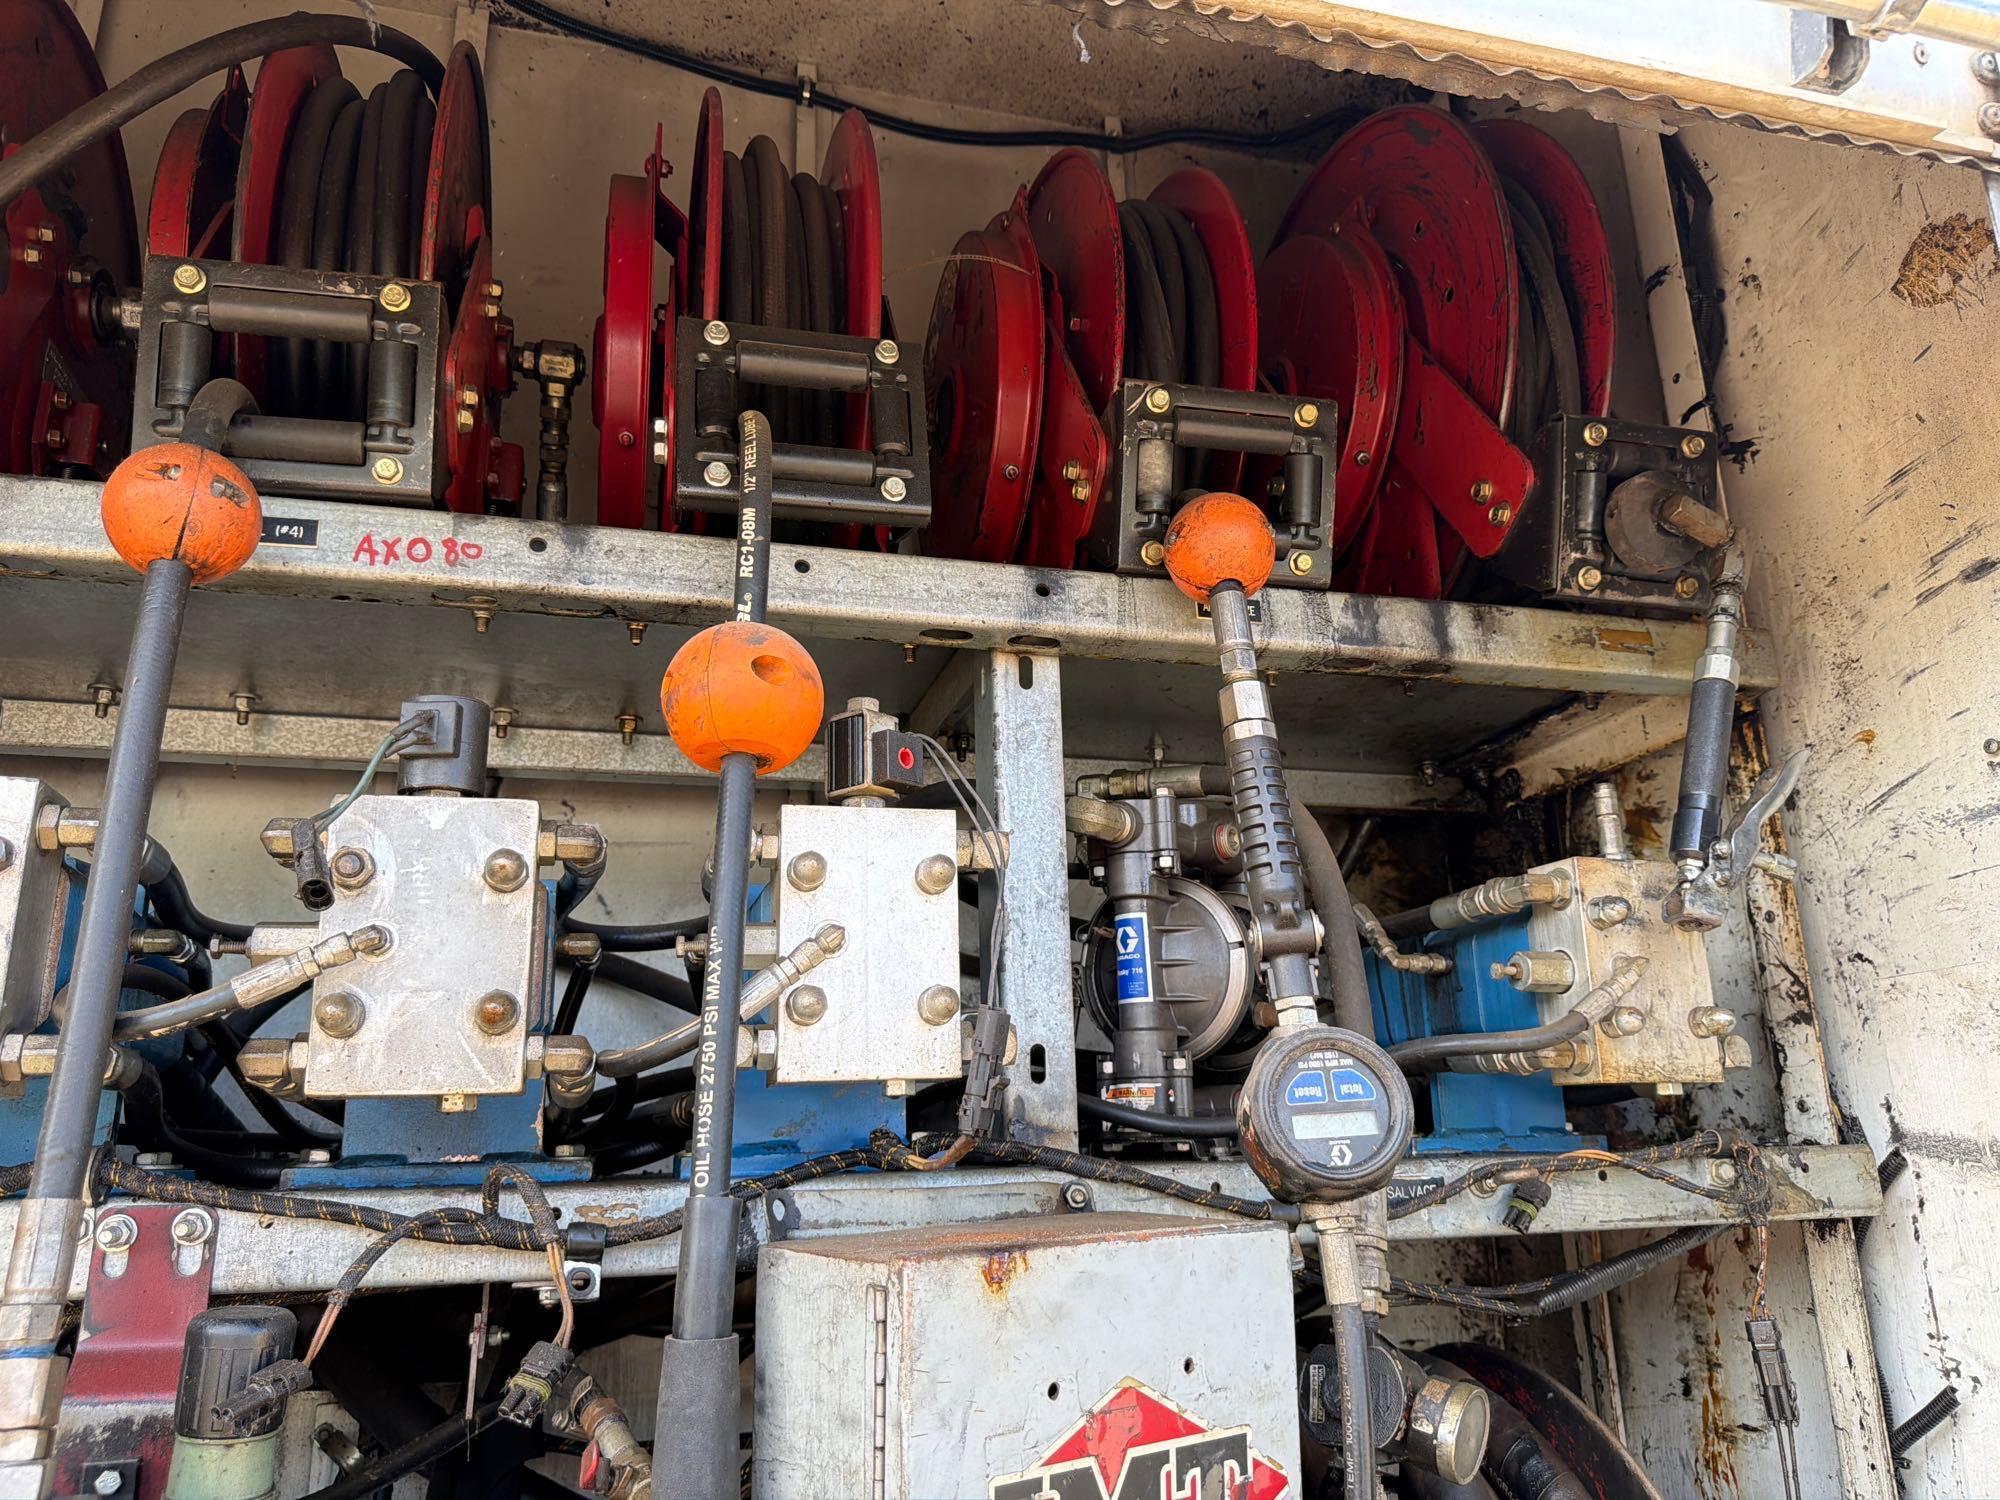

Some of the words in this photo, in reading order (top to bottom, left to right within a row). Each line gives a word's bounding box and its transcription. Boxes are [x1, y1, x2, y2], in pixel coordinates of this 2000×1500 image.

[744, 440, 757, 470] REEL
[275, 524, 304, 539] (#4)
[740, 507, 756, 578] RC1-08M
[706, 958, 722, 1001] MAX
[703, 1005, 719, 1036] PSI
[700, 1041, 717, 1085] 2750
[1294, 1086, 1322, 1098] Reset
[1340, 1083, 1363, 1096] Total
[697, 1089, 714, 1148] HOSE
[694, 1152, 711, 1188] OIL
[1338, 1337, 1348, 1376] MADE
[1345, 1453, 1355, 1490] TEMP
